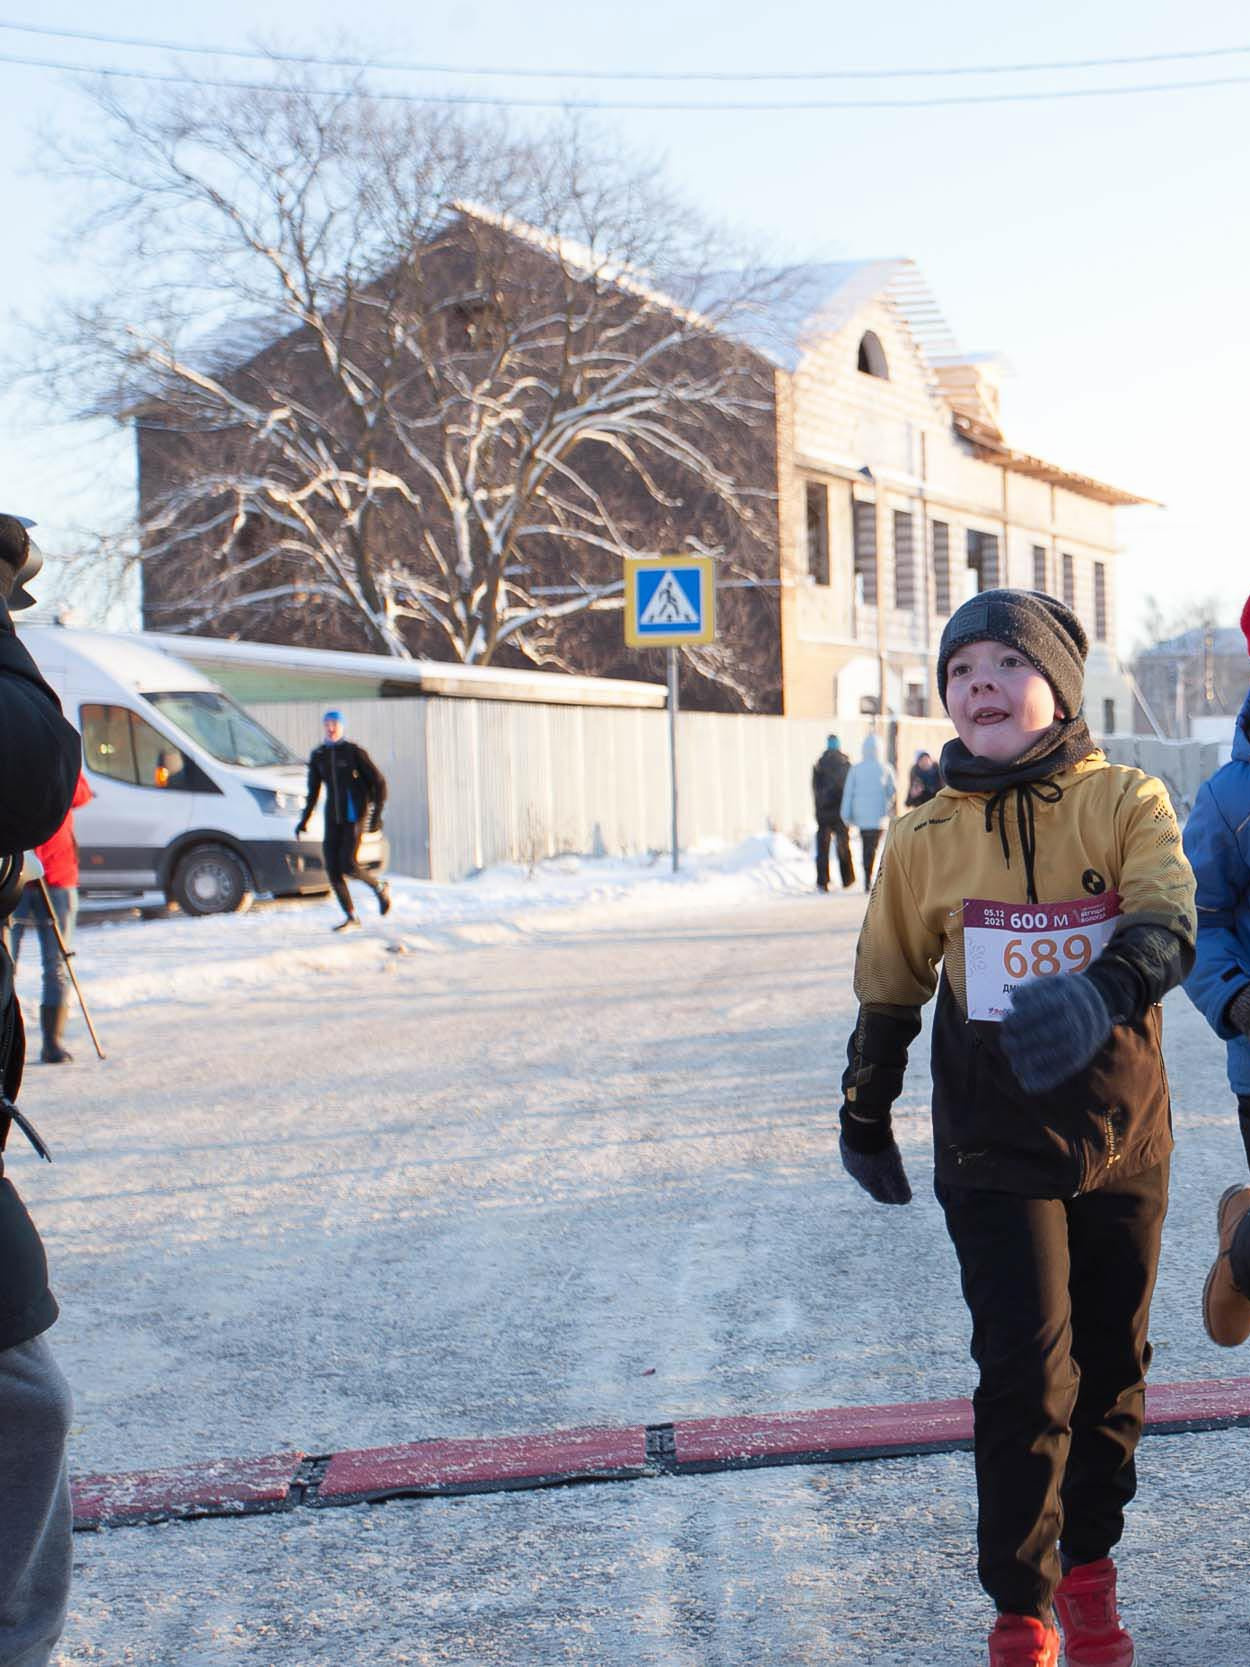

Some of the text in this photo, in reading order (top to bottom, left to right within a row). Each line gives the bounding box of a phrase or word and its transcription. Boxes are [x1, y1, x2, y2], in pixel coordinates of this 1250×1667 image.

[984, 909, 1005, 918] 05.12
[984, 918, 1005, 926] 2021
[1010, 913, 1068, 928] 600 М
[1003, 934, 1092, 979] 689
